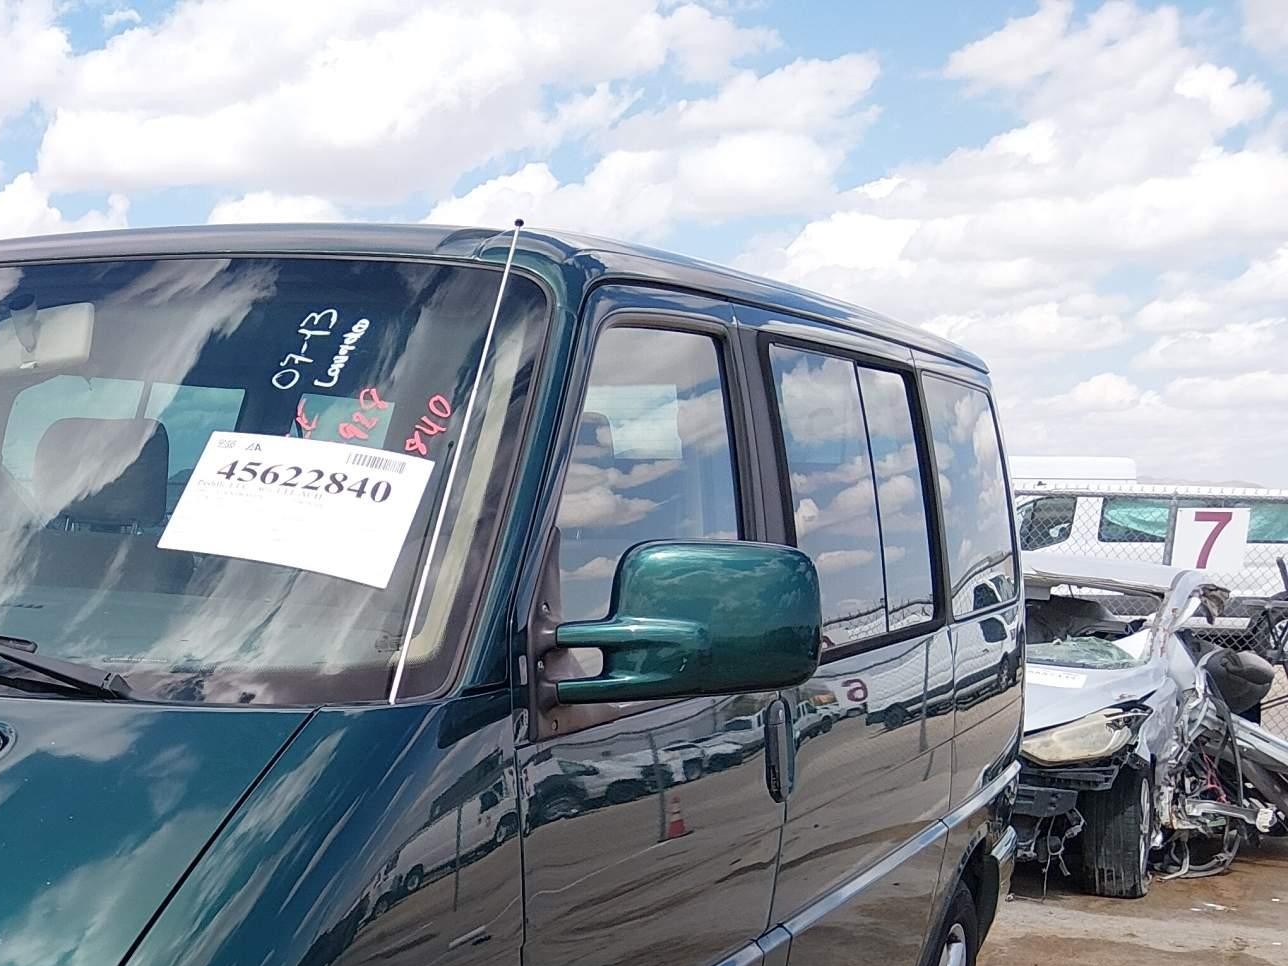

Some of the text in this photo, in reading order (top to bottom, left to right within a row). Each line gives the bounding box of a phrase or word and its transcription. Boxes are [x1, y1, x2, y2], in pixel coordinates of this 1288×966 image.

[272, 309, 337, 389] 07-13
[405, 395, 451, 455] 840
[216, 460, 392, 503] 45622840
[1194, 511, 1233, 569] 7
